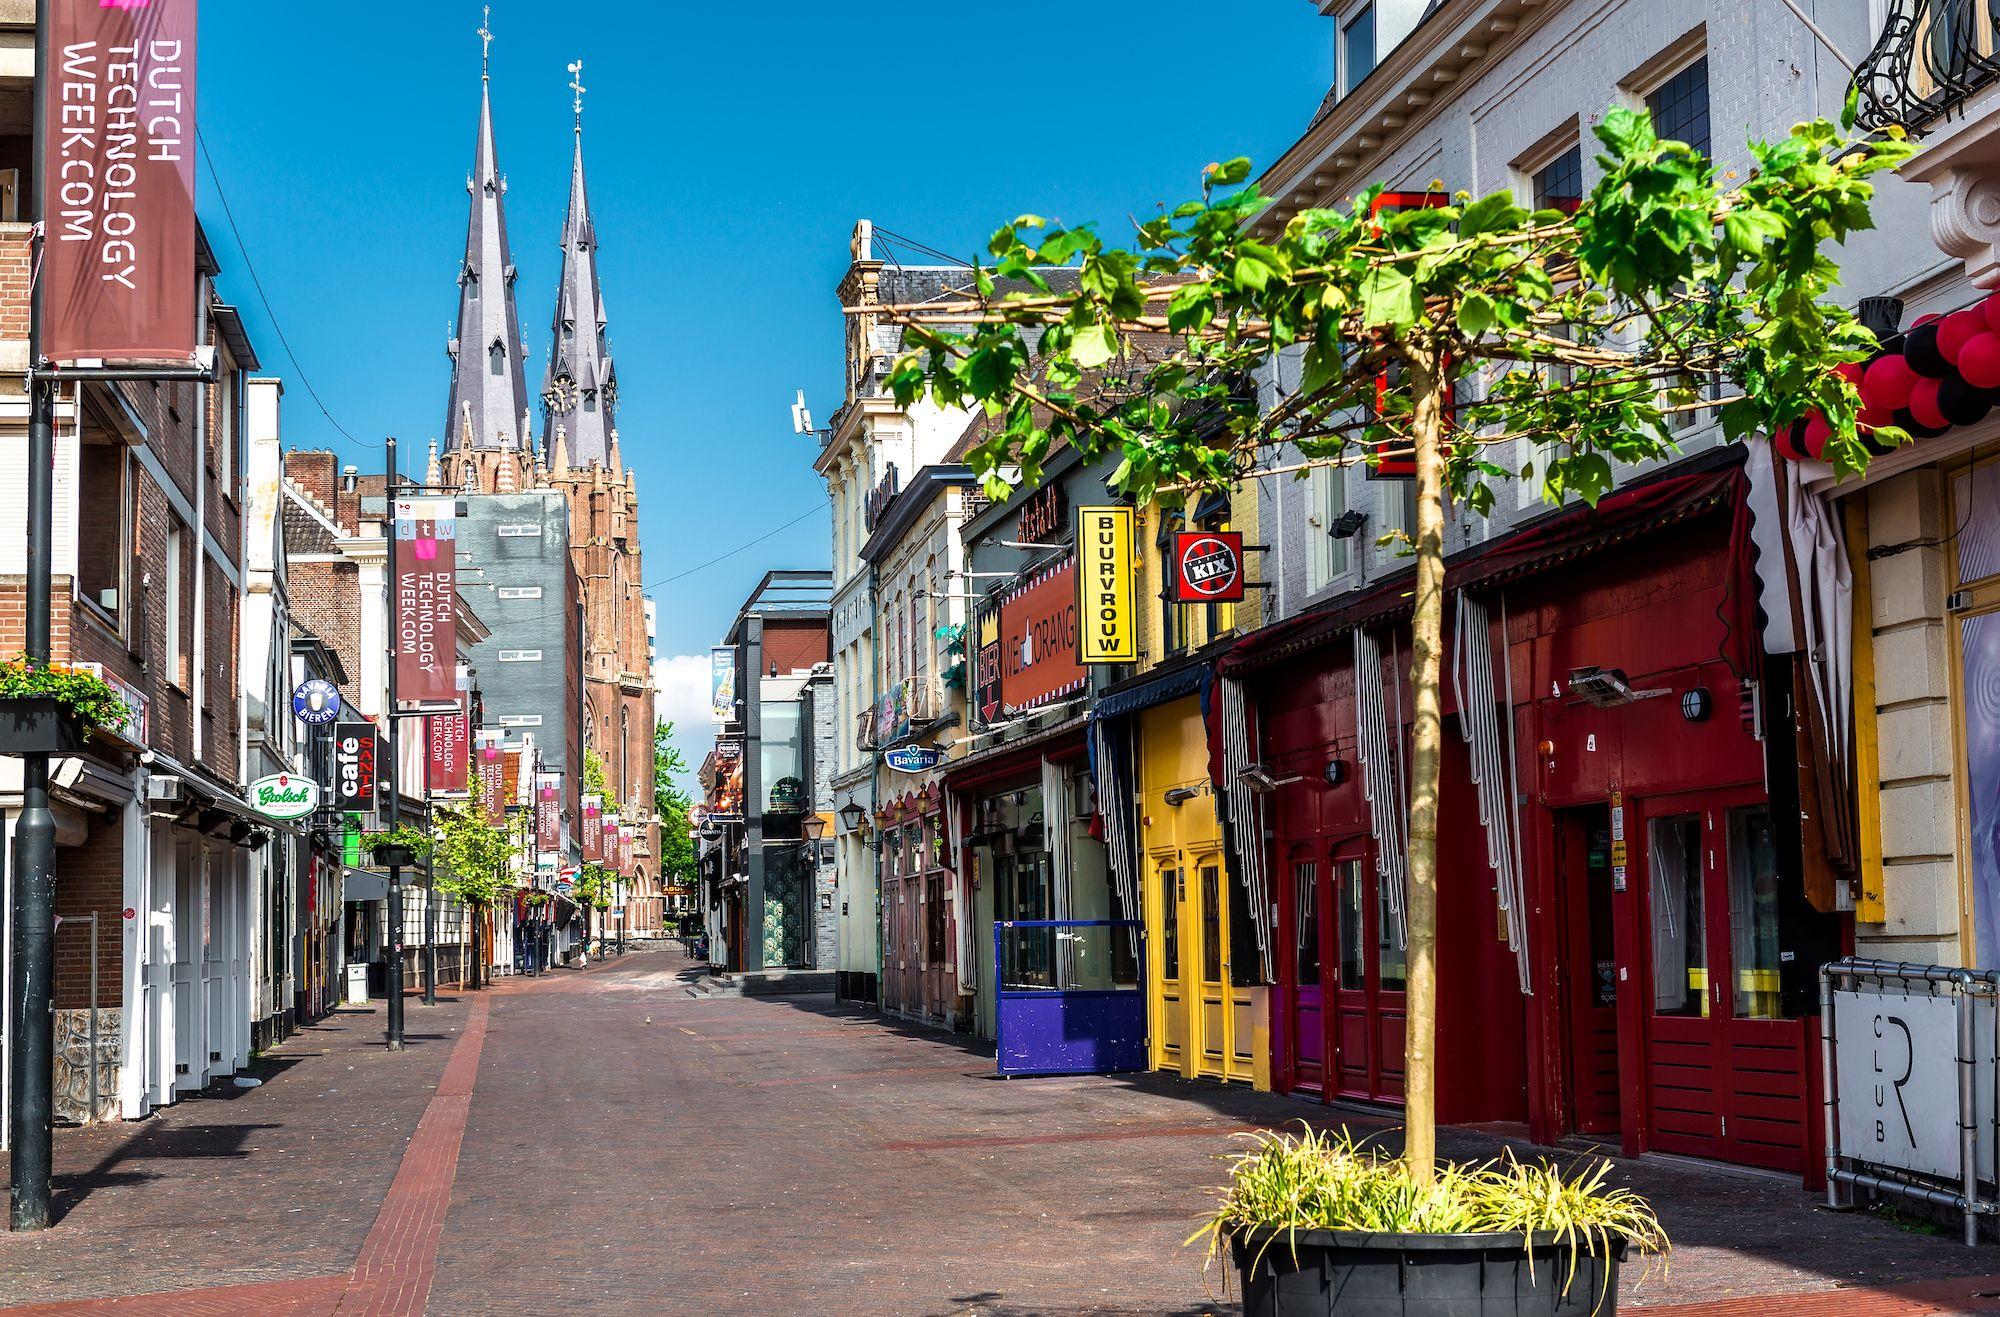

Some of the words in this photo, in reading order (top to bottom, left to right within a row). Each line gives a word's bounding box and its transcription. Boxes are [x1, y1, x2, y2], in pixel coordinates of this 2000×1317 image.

[148, 39, 181, 161] DUTCH
[60, 40, 97, 241] WEEK.COM
[103, 38, 138, 289] TECHNOLOGY
[436, 572, 451, 622] DUTCH
[1097, 516, 1121, 652] BUURVROUW
[1192, 558, 1230, 580] KIX
[401, 572, 416, 654] WEEK.COM
[418, 572, 434, 673] TECHNOLOGY
[1033, 604, 1076, 664] ORANG
[296, 681, 336, 700] BAVARIA
[980, 642, 1001, 688] BIER
[299, 707, 335, 723] BIEREN
[444, 715, 454, 773] ECHNOLOGY
[336, 737, 360, 797] café
[495, 764, 503, 789] DUTCH
[893, 754, 934, 766] Bavaria
[257, 785, 309, 806] Grolsch
[1873, 1014, 1885, 1142] CLUB
[1887, 1016, 1917, 1149] R
